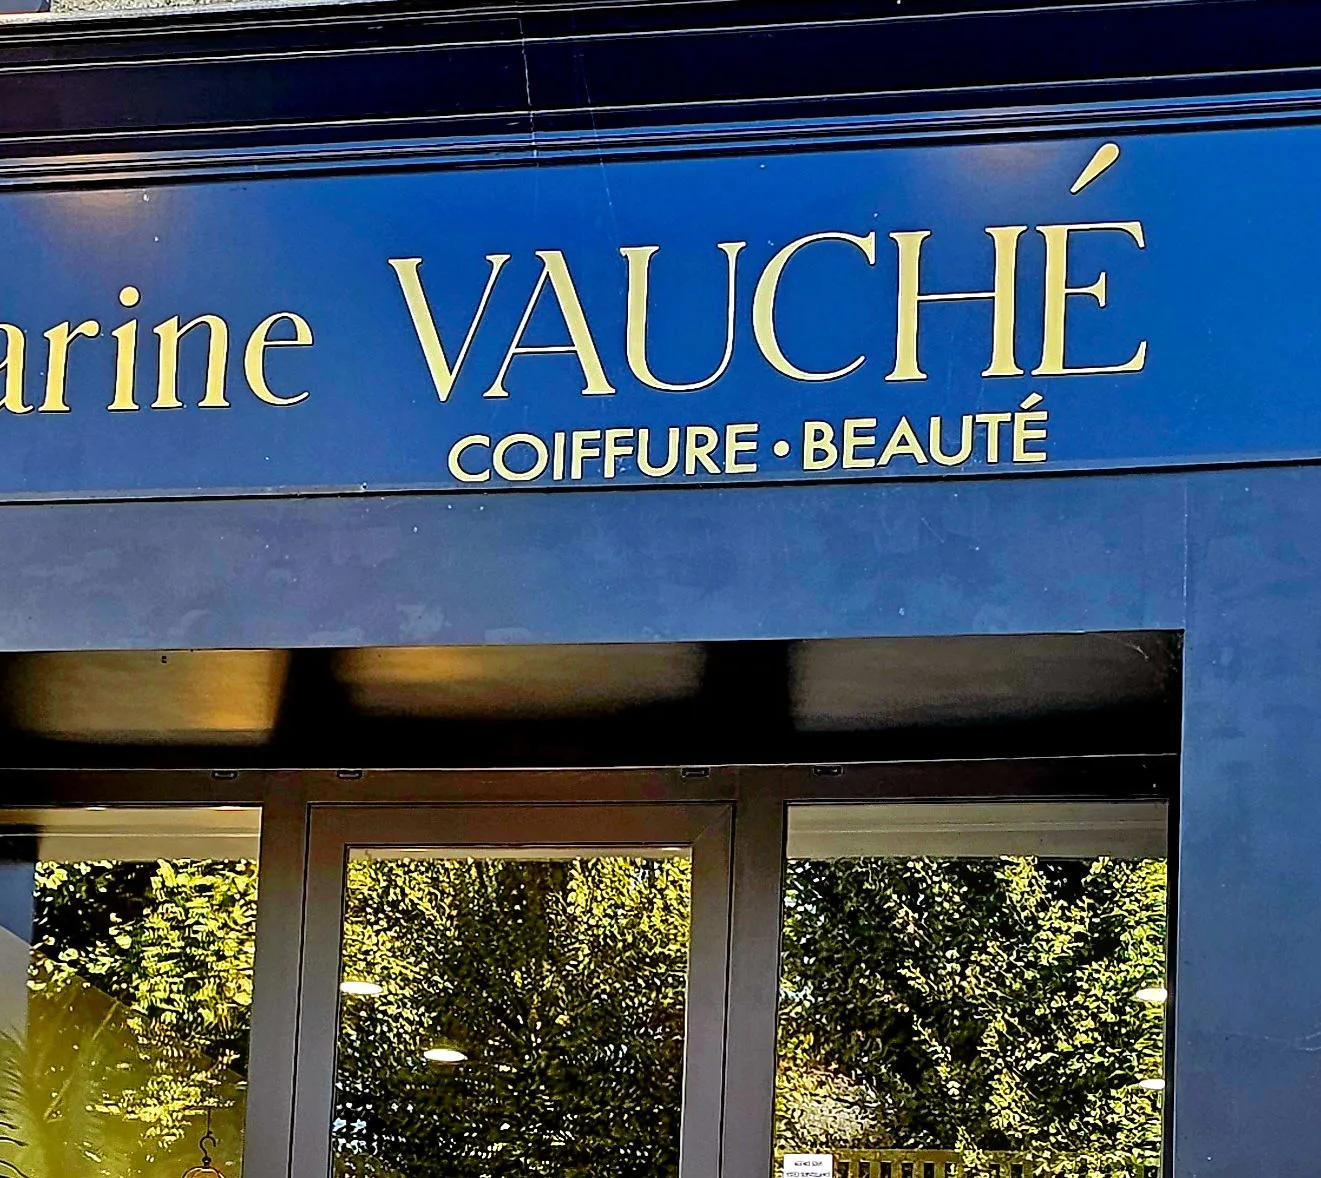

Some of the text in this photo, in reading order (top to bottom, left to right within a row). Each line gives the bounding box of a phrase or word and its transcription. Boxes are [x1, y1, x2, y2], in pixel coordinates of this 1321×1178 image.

[388, 144, 1147, 404] VAUCHÉ
[447, 391, 1049, 486] COIFFURE BEAUTÉ
